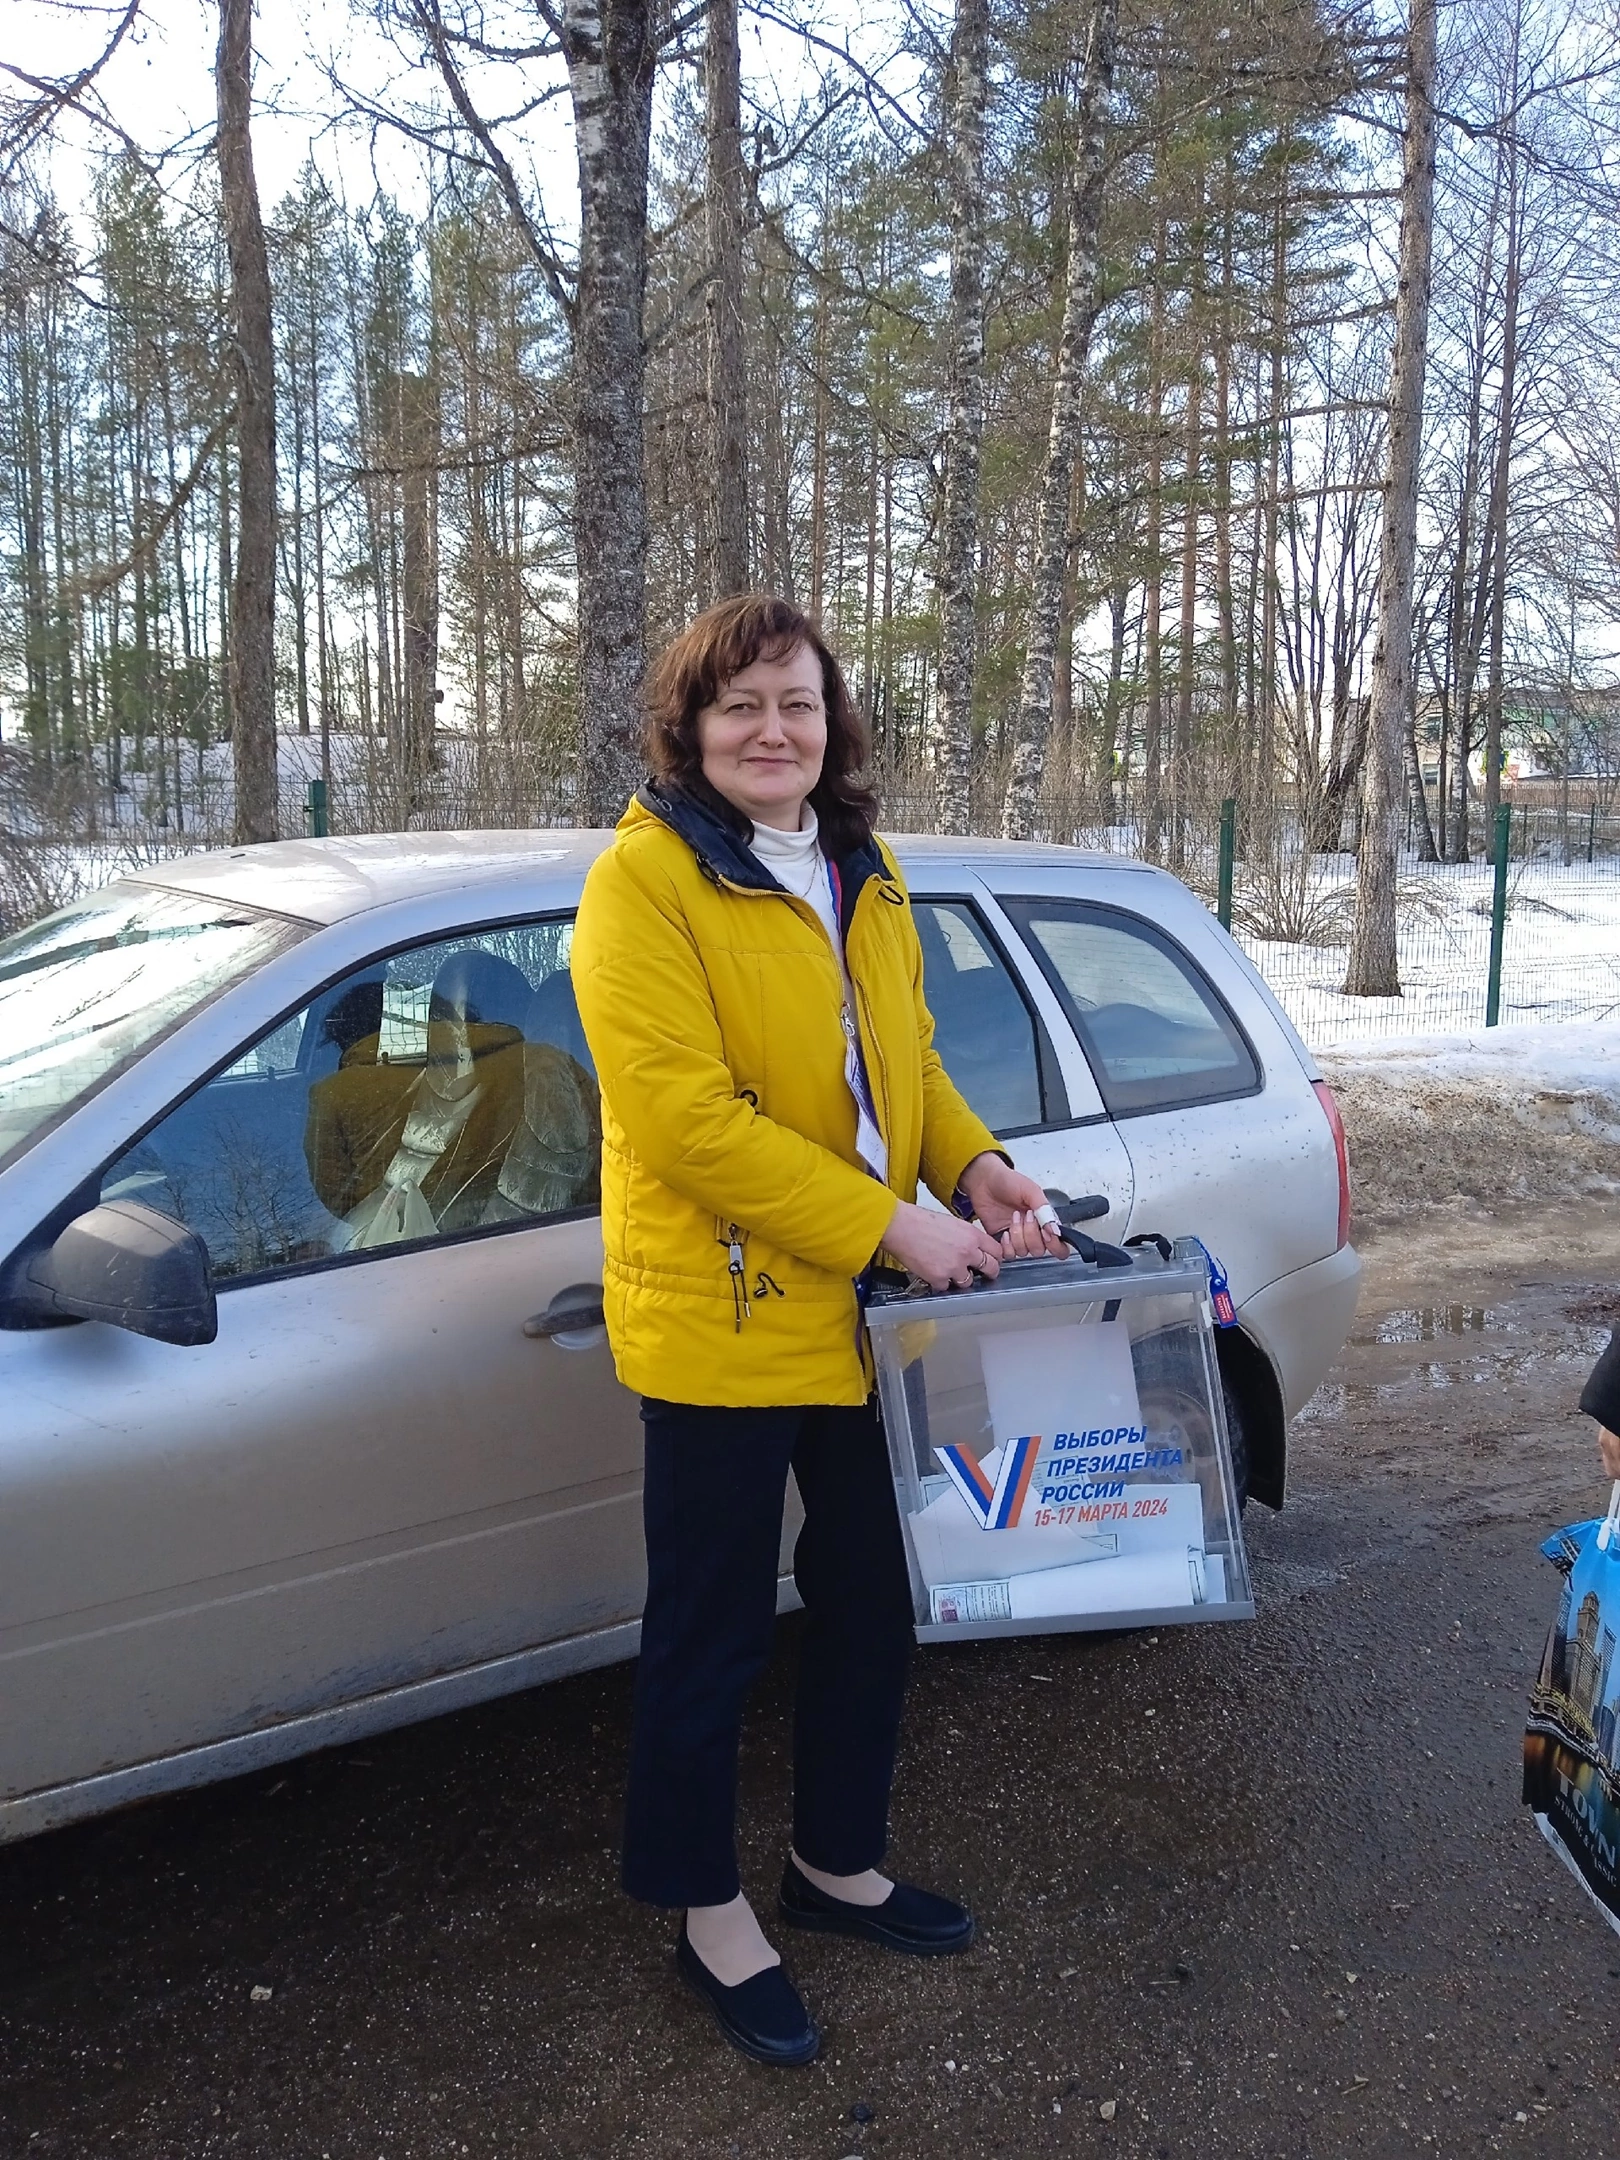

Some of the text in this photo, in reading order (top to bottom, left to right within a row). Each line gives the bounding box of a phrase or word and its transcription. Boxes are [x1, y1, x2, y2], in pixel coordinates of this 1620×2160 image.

[1053, 1425, 1148, 1451] ВЫБОРЫ
[1046, 1448, 1183, 1478] ПРЕЗИДЕНТА
[1040, 1480, 1125, 1504] РОССИИ
[1034, 1498, 1169, 1527] 15-17 МАРТА 2024
